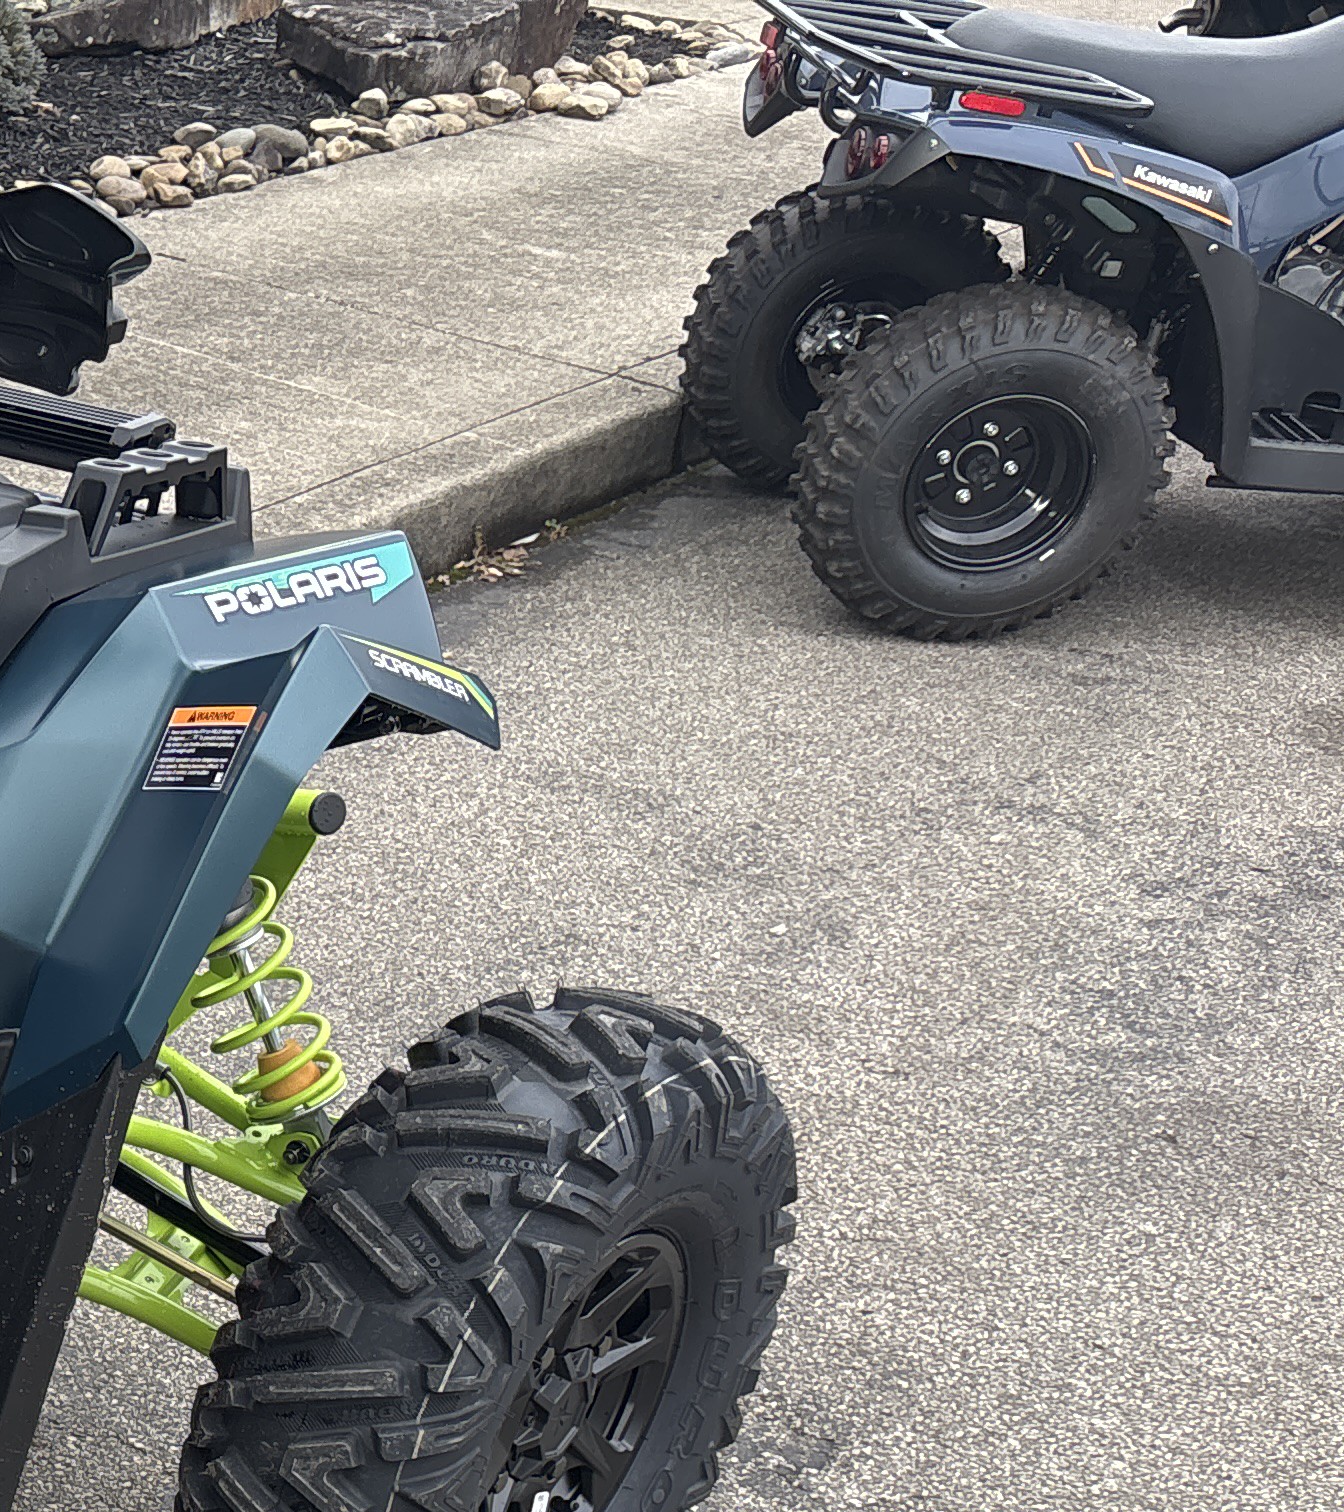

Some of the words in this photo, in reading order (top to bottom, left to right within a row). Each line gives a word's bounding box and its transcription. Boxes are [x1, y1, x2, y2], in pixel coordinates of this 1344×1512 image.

[1133, 164, 1212, 203] Kawasaki
[202, 556, 387, 624] POLARIS
[367, 648, 470, 702] SCRAMBLER
[196, 711, 236, 721] WARNING
